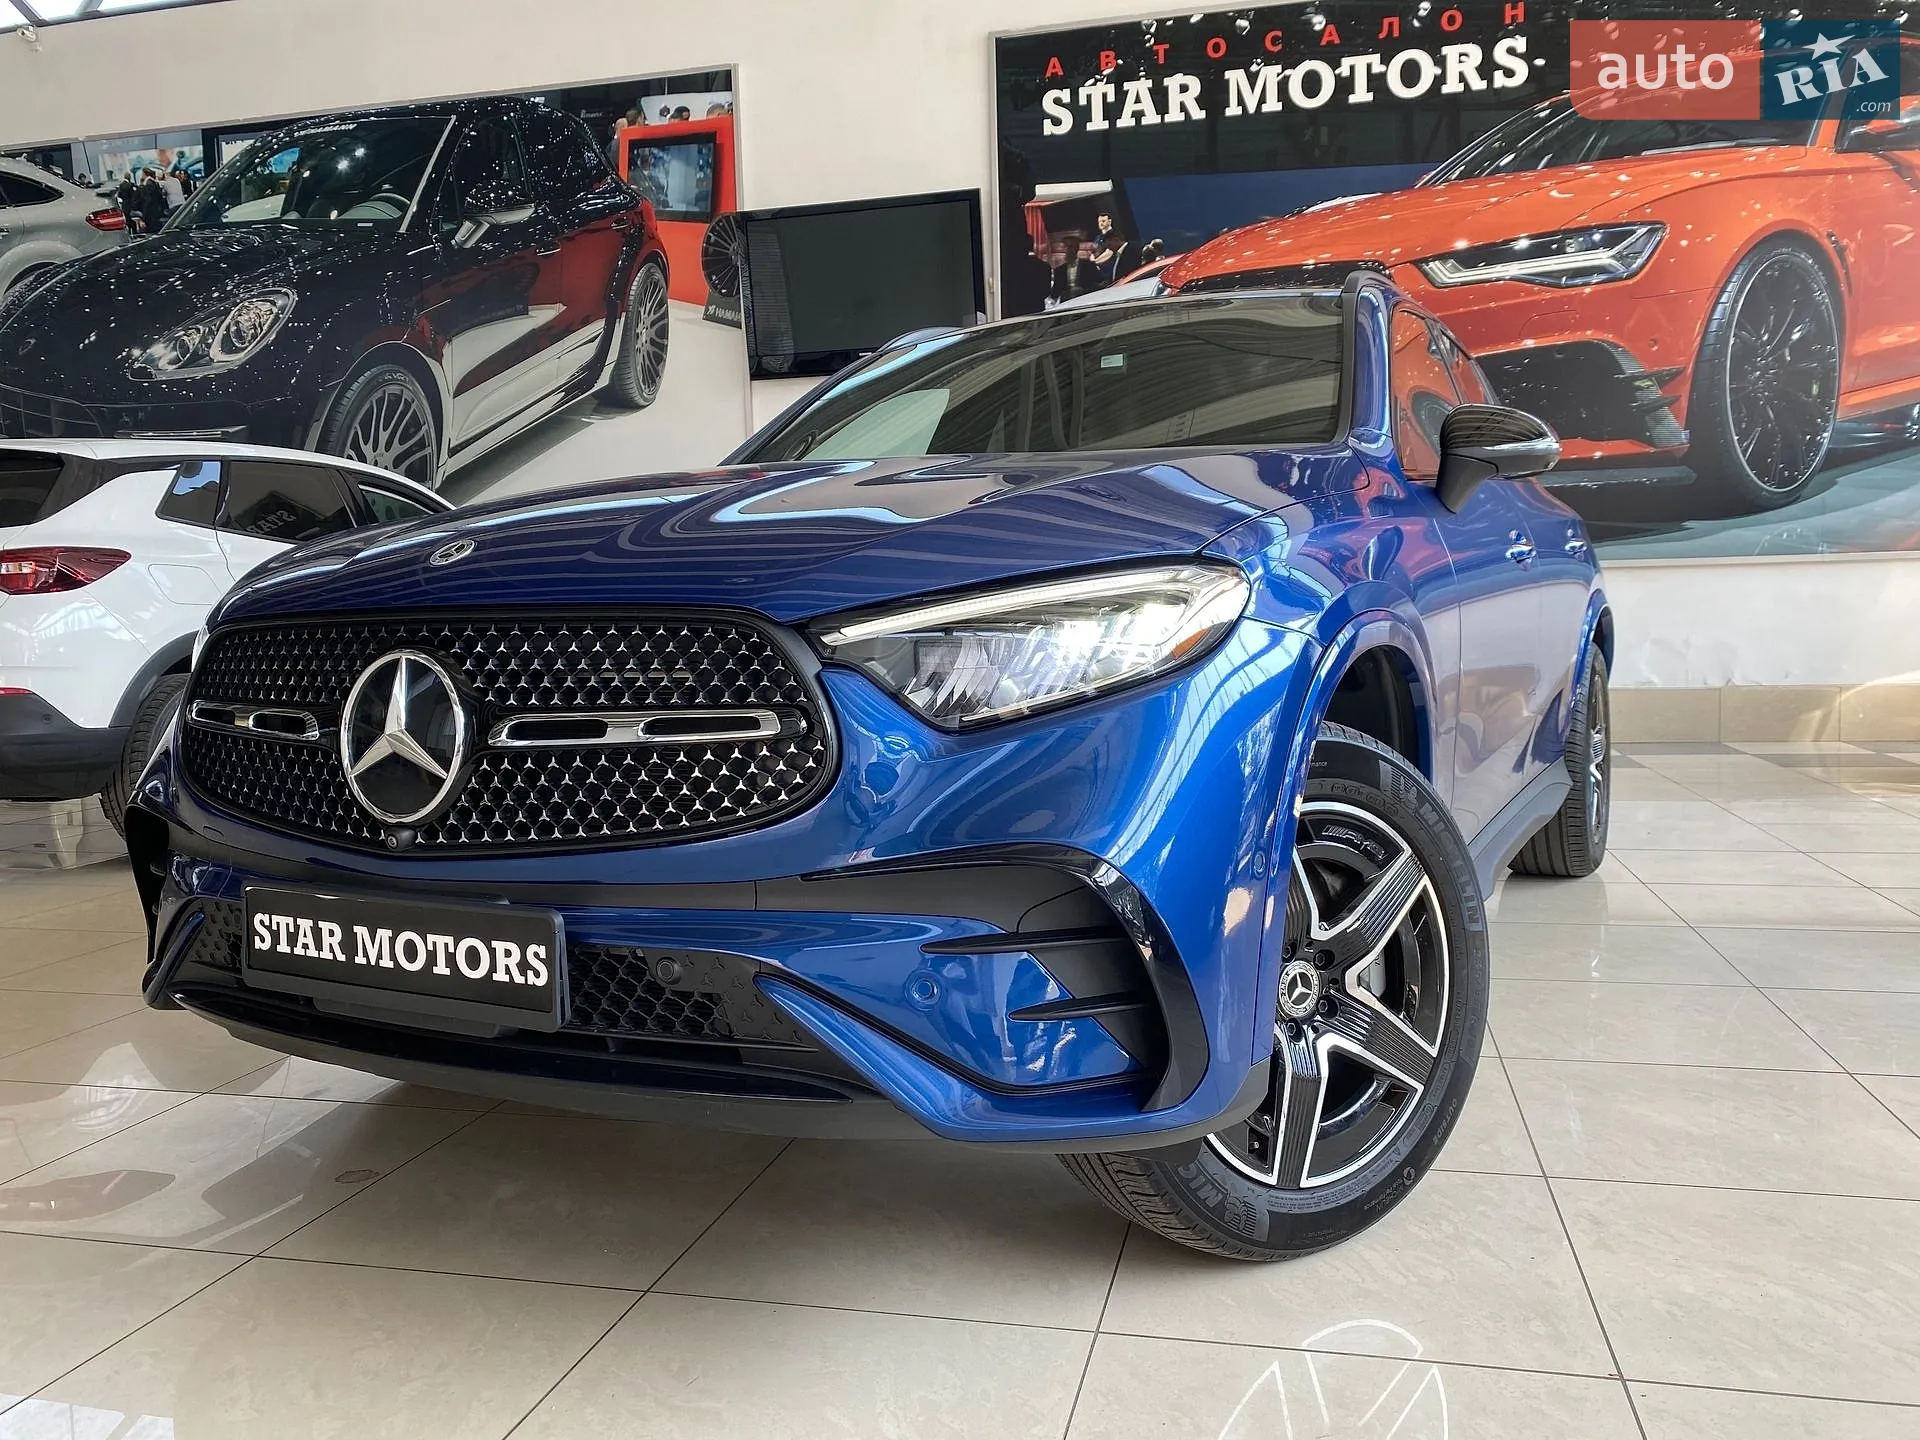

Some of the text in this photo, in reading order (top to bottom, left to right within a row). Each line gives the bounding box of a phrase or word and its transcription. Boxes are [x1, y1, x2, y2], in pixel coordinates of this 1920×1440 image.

[1041, 36, 1529, 136] STAR MOTORS
[253, 912, 549, 987] STAR MOTORS
